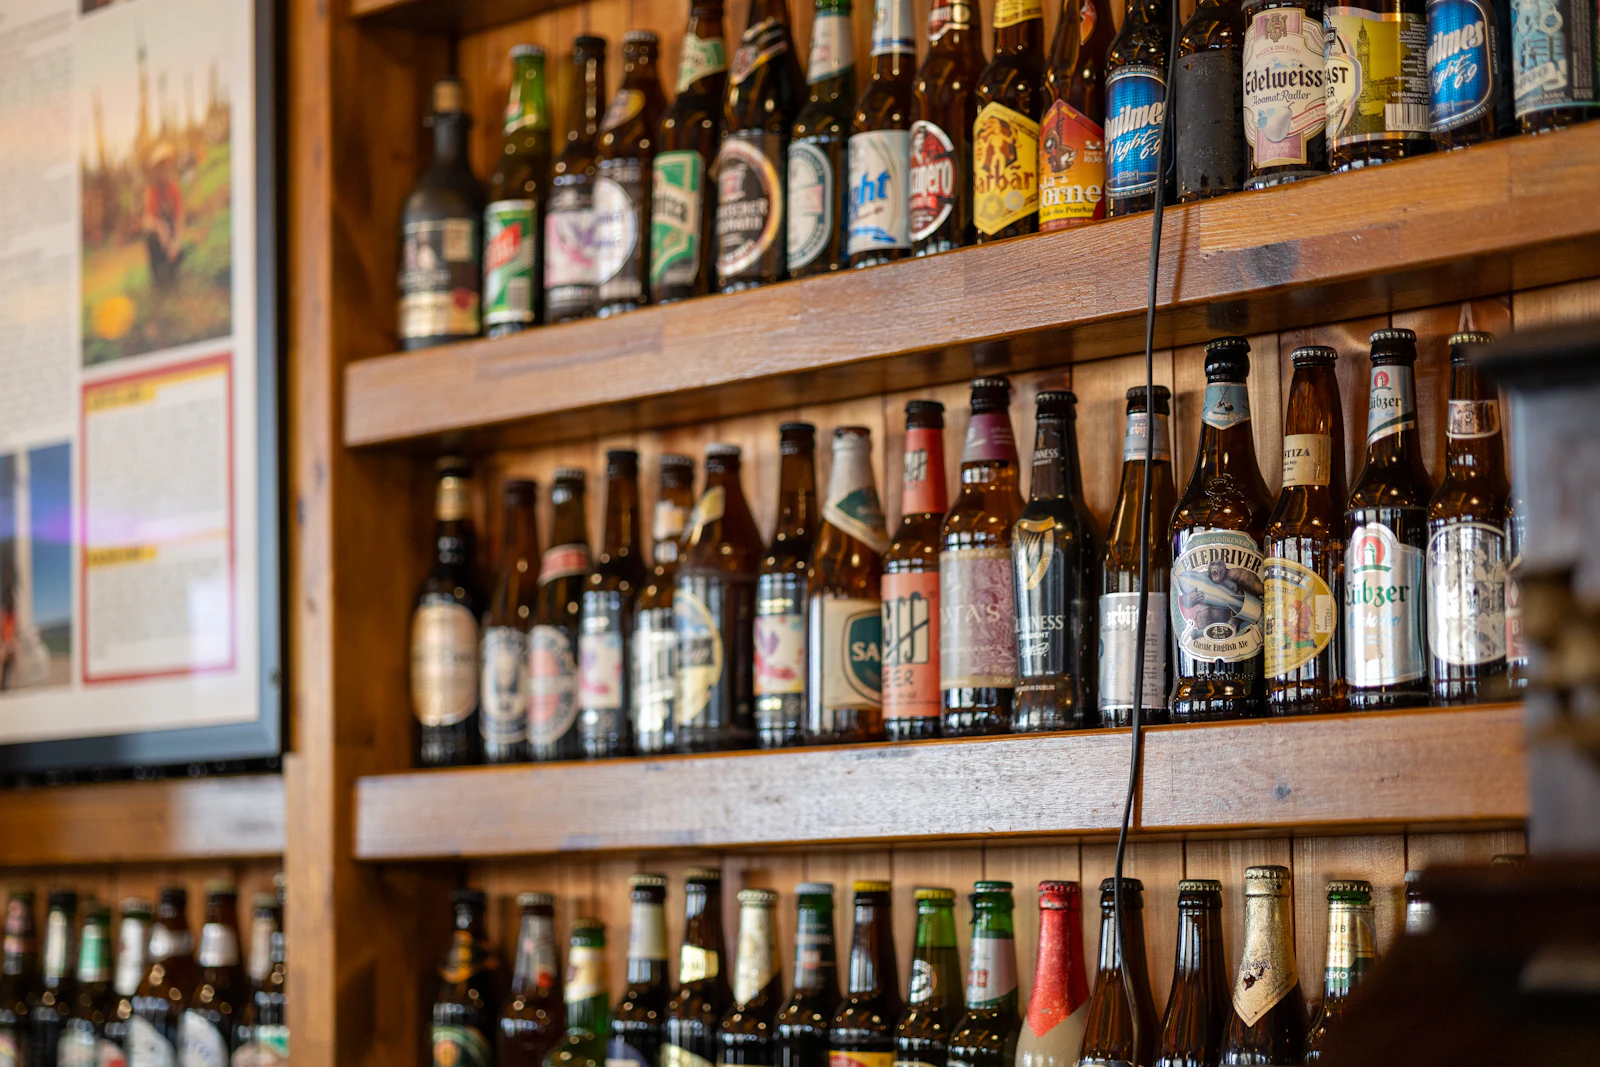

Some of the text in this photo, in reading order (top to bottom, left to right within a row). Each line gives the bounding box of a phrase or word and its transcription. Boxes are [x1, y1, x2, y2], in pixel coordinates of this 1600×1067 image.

[1245, 63, 1323, 96] Edelweiss
[1324, 66, 1348, 84] AST
[1453, 63, 1478, 89] 6.9
[1252, 89, 1311, 106] Hoamat Radler
[1104, 101, 1166, 152] Quilme
[1040, 184, 1103, 208] orne
[1183, 548, 1262, 573] PILEDRIVER
[1345, 578, 1410, 608] Lübzer
[1012, 614, 1065, 634] INNESS
[1193, 640, 1249, 652] Classic English Ale
